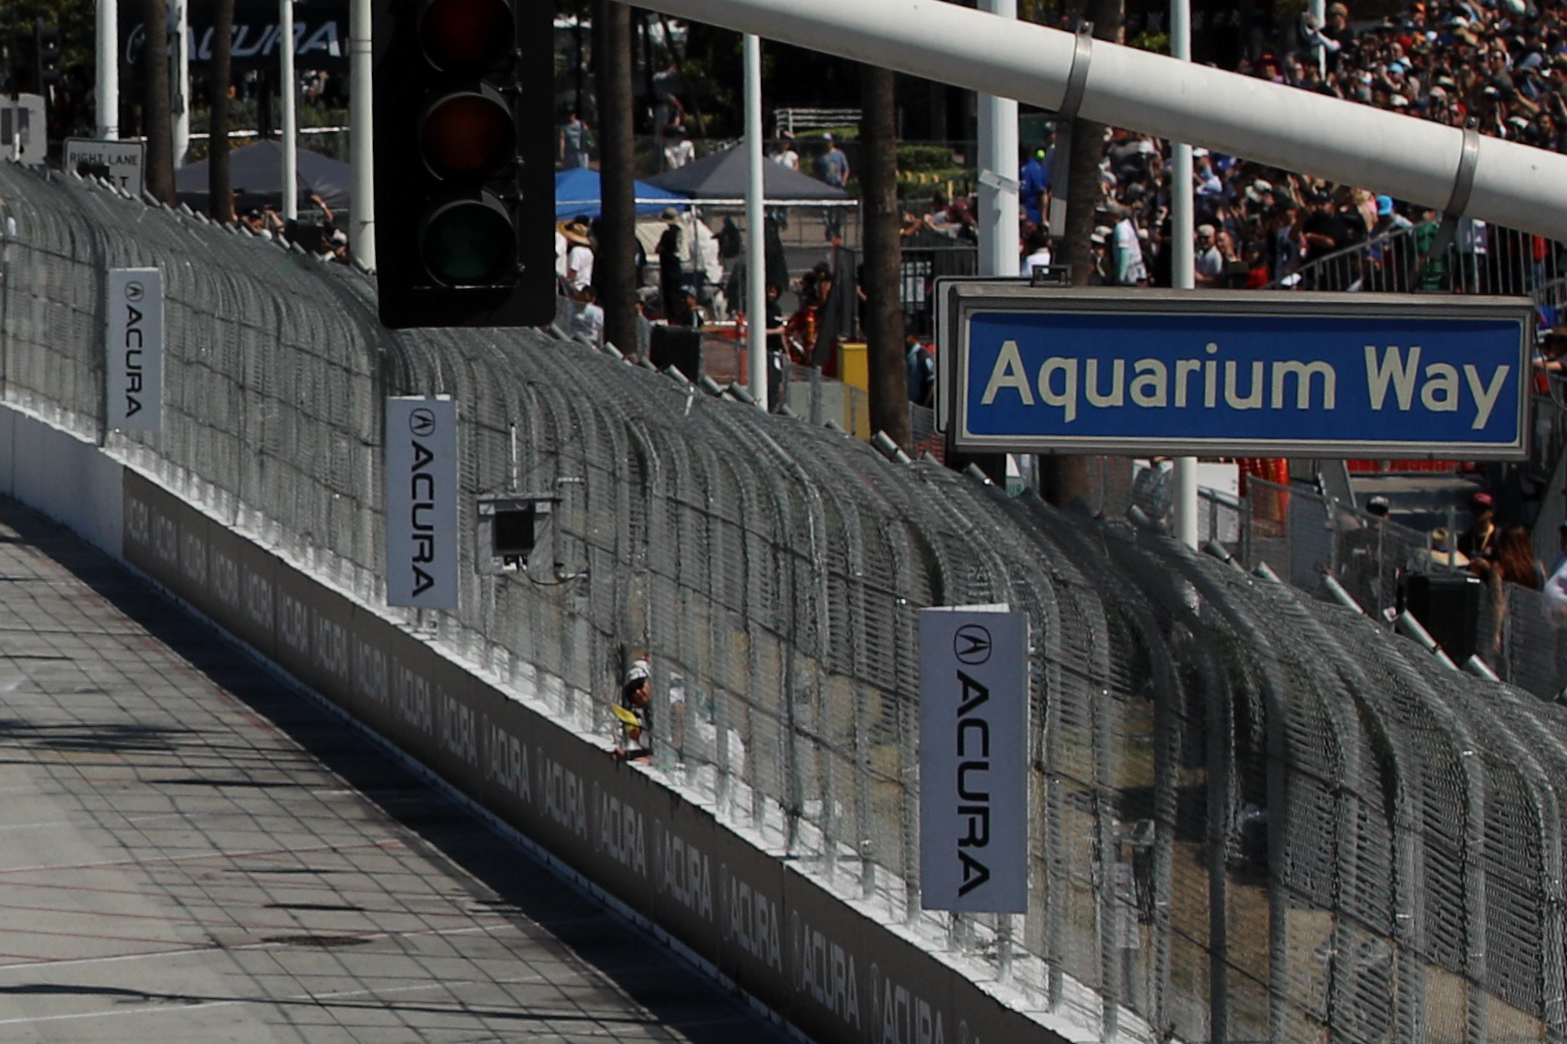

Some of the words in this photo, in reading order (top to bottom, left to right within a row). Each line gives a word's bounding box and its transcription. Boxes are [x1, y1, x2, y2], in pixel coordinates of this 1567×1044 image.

[108, 153, 138, 167] LANE
[125, 304, 143, 419] ACURA
[980, 339, 1335, 424] Aquarium
[1363, 345, 1510, 430] Way
[411, 438, 434, 598] ACURA
[491, 723, 531, 804] ACURA
[545, 757, 587, 842] ACURA
[957, 668, 990, 898] ACURA
[601, 791, 647, 879] ACURA
[664, 829, 713, 924] ACURA
[730, 875, 782, 975] ACURA
[802, 923, 861, 1031] ACURA
